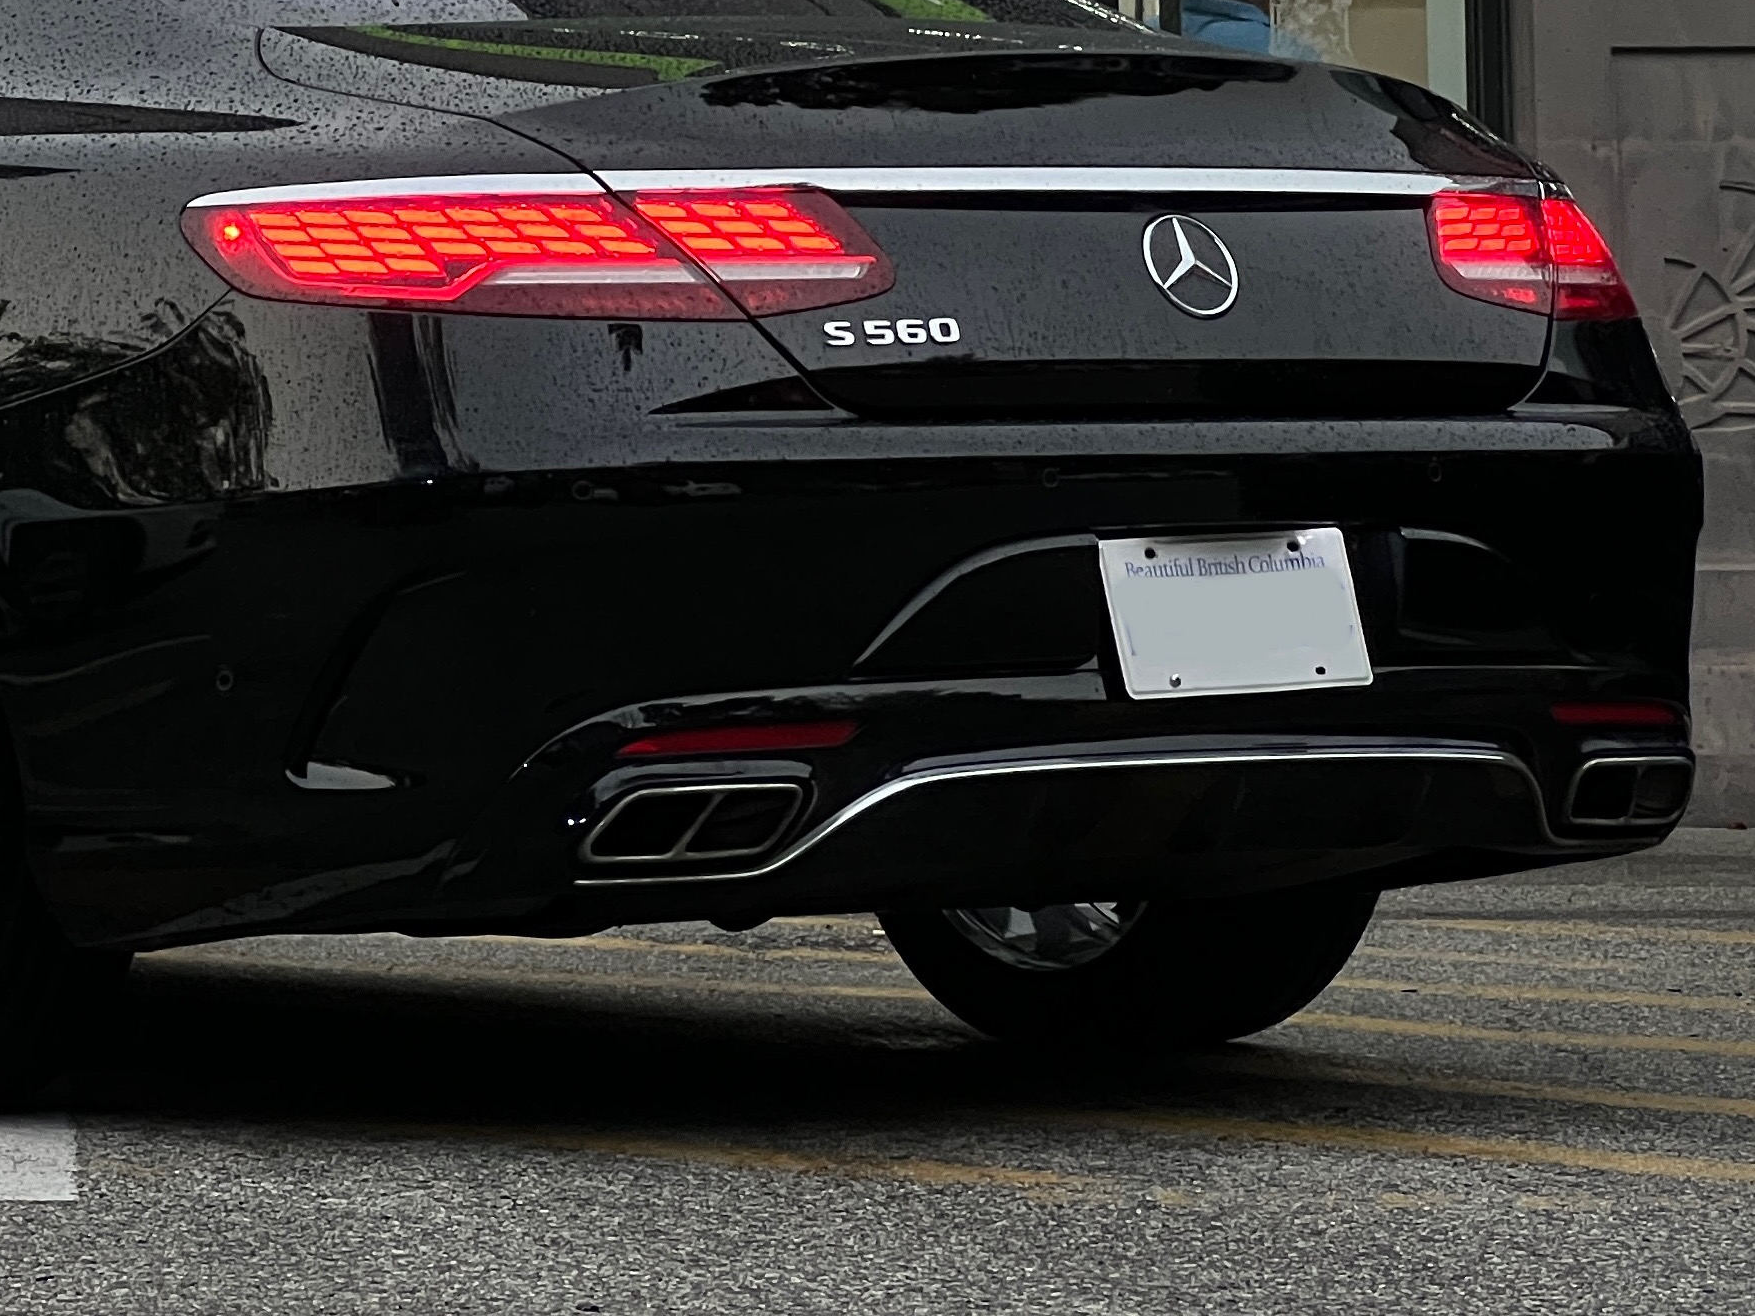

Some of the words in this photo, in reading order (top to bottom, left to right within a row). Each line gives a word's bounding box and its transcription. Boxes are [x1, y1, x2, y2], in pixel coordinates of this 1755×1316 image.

[823, 320, 856, 346] S
[862, 317, 961, 345] 560
[1124, 557, 1195, 578] Beautiful
[1197, 555, 1245, 577] British
[1248, 552, 1325, 573] Columbia
